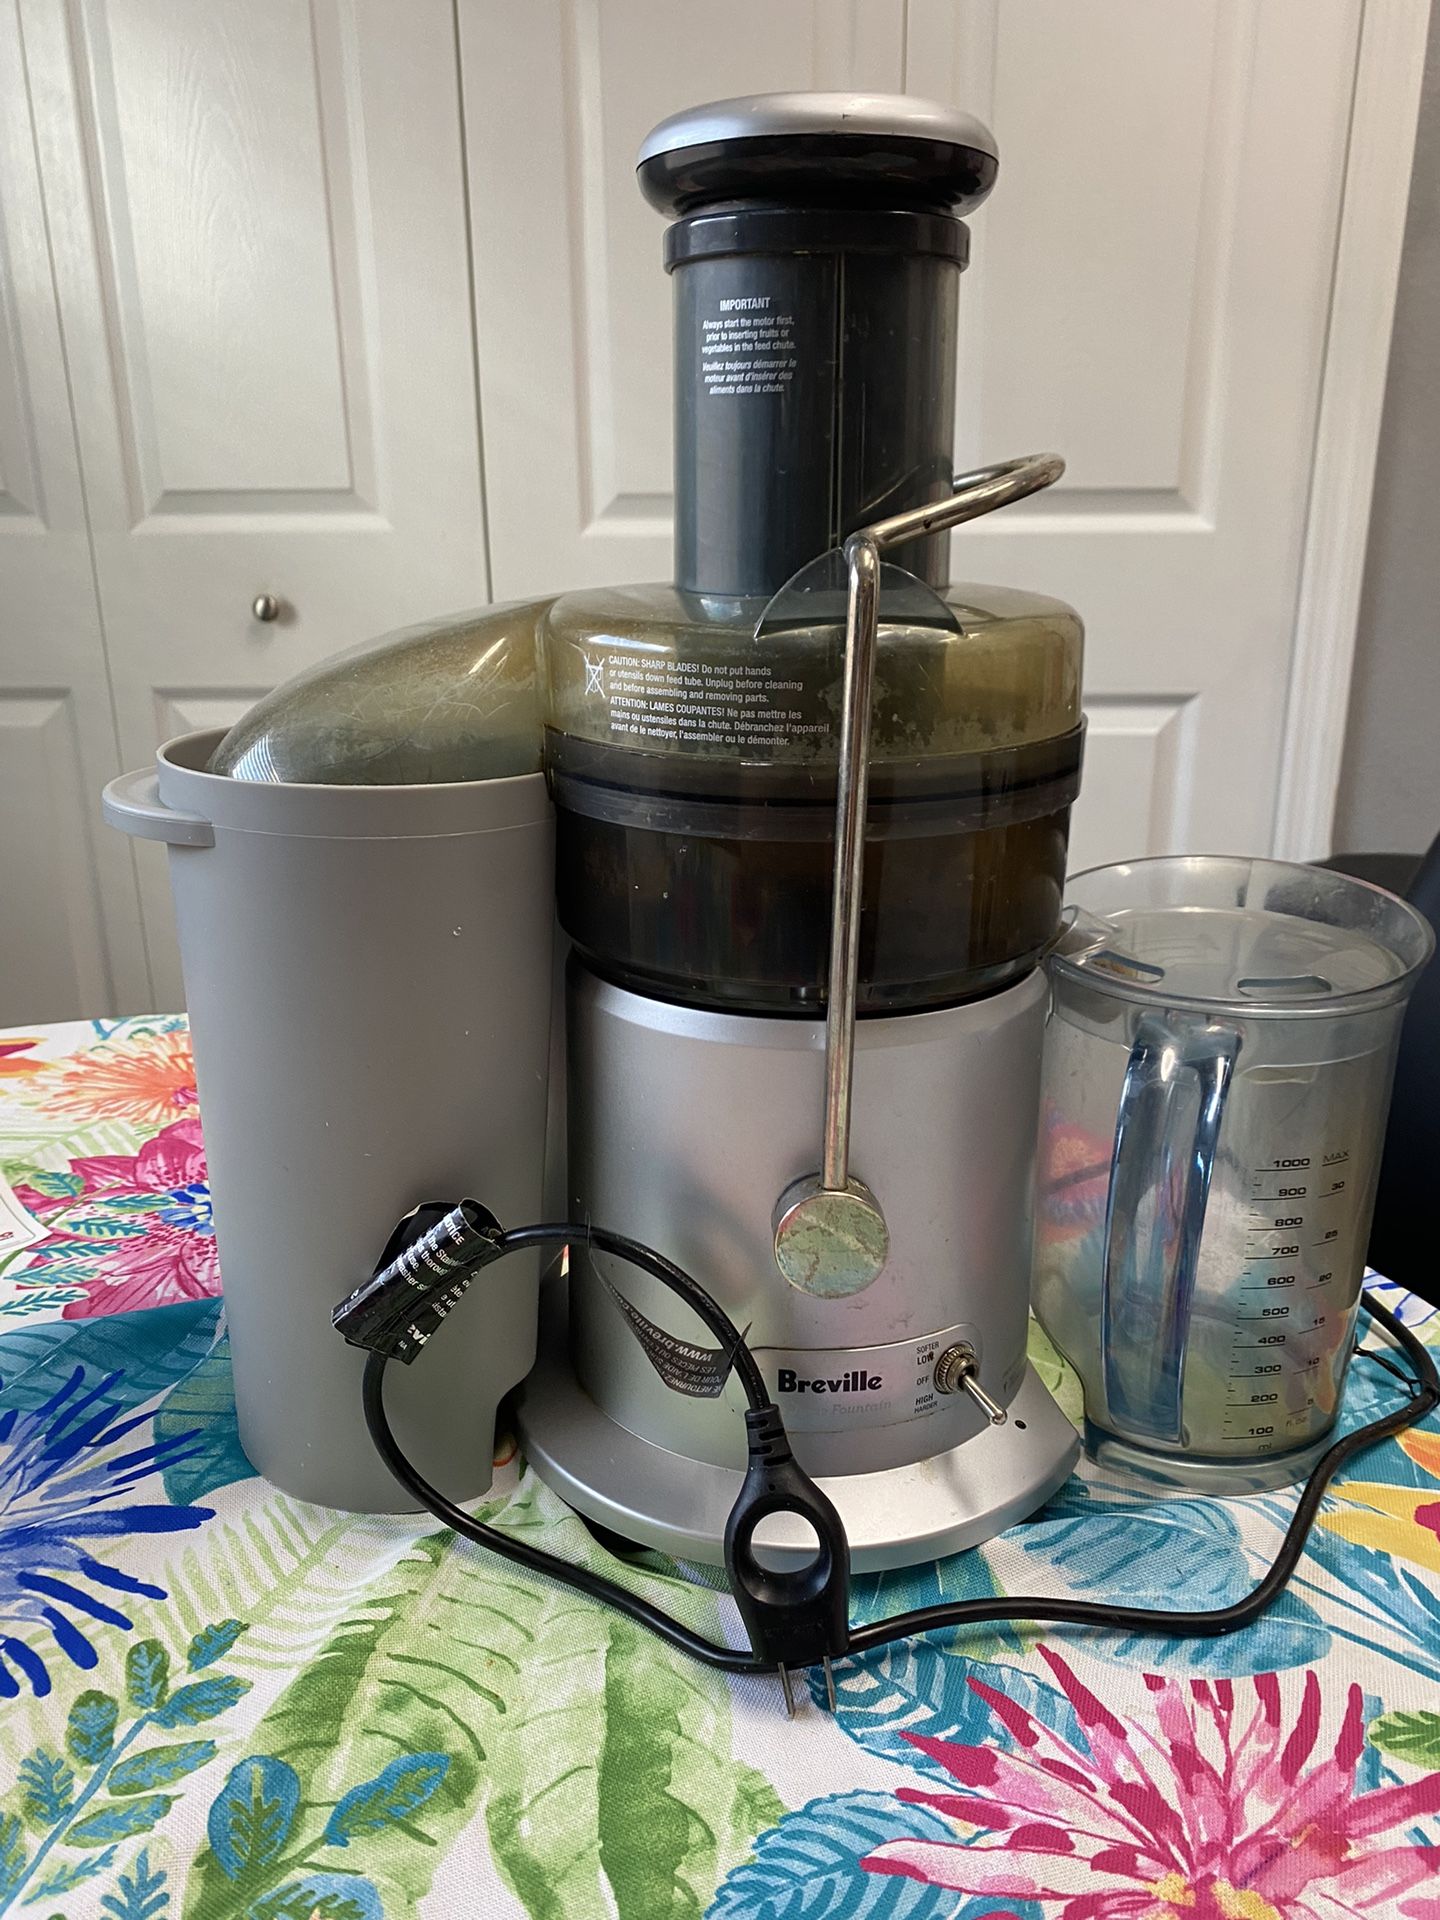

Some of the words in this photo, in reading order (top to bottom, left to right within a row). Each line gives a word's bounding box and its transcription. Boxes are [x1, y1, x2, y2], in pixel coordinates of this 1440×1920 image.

[720, 298, 770, 311] IMPORTANT
[703, 320, 723, 330] Always
[724, 318, 739, 328] start
[740, 318, 751, 327] the
[753, 317, 774, 326] motor
[776, 316, 794, 325] first,
[706, 333, 720, 343] prior
[729, 330, 758, 340] inserting
[759, 329, 779, 338] fruits
[702, 344, 733, 355] vegetables
[734, 343, 740, 351] in
[742, 342, 753, 351] the
[755, 341, 770, 350] feed
[703, 362, 724, 371] Veuillez
[725, 361, 751, 371] toujours
[753, 360, 787, 369] démarrer
[789, 359, 796, 368] le
[705, 374, 725, 383] moteur
[726, 373, 744, 382] avant
[778, 371, 793, 380] des
[709, 385, 735, 394] aliments
[736, 384, 752, 393] dans
[754, 384, 761, 393] la
[608, 656, 640, 666] CAUTION:
[641, 659, 665, 669] SHARP
[667, 662, 699, 673] BLADES!
[702, 664, 712, 674] Do
[714, 666, 727, 675] not
[729, 666, 743, 676] put
[745, 666, 772, 676] hands
[618, 669, 644, 680] utensils
[645, 673, 664, 682] down
[667, 674, 682, 684] feed
[684, 676, 703, 686] tube.
[705, 678, 733, 689] Unplug
[736, 679, 762, 689] before
[765, 680, 803, 691] cleaning
[610, 682, 621, 690] and
[623, 682, 644, 693] before
[646, 686, 687, 699] assembling
[689, 691, 703, 699] and
[705, 692, 743, 703] removing
[745, 694, 769, 703] parts.
[610, 696, 648, 709] ATTENTION:
[649, 701, 674, 713] LAMES
[676, 704, 724, 716] COUPANTES!
[727, 708, 738, 717] Ne
[741, 710, 755, 719] pas
[758, 710, 786, 719] mettre
[789, 710, 802, 719] les
[610, 709, 630, 720] mains
[641, 714, 676, 726] ustensiles
[678, 717, 697, 727] dans
[699, 718, 705, 728] la
[708, 720, 732, 730] chute.
[734, 721, 784, 732] Débranchez
[786, 723, 830, 734] l'appareil
[611, 722, 628, 732] avant
[630, 724, 638, 733] de
[640, 725, 646, 734] le
[648, 727, 678, 739] nettoyer,
[679, 730, 724, 742] l'assembler
[725, 735, 736, 743] ou
[738, 734, 745, 744] le
[748, 735, 790, 746] démonter.
[1323, 1151, 1349, 1162] MAX
[1273, 1158, 1310, 1168] 1000
[1332, 1181, 1345, 1190] 30
[1278, 1187, 1306, 1197] 900
[1275, 1217, 1303, 1227] 800
[1325, 1230, 1338, 1239] 25
[1272, 1246, 1299, 1255] 700
[1267, 1276, 1295, 1285] 600
[1319, 1273, 1332, 1282] 20
[1262, 1307, 1290, 1316] 500
[1313, 1317, 1325, 1326] 15
[1258, 1335, 1286, 1344] 400
[916, 1341, 939, 1354] SOFTER
[917, 1351, 934, 1365] LOW
[1308, 1357, 1319, 1366] 10
[1254, 1364, 1281, 1374] 300
[778, 1369, 882, 1393] Breville
[917, 1375, 929, 1386] OFF
[916, 1393, 933, 1405] HIGH
[1251, 1393, 1278, 1402] 200
[914, 1401, 938, 1414] HARDER
[1249, 1426, 1274, 1435] 100
